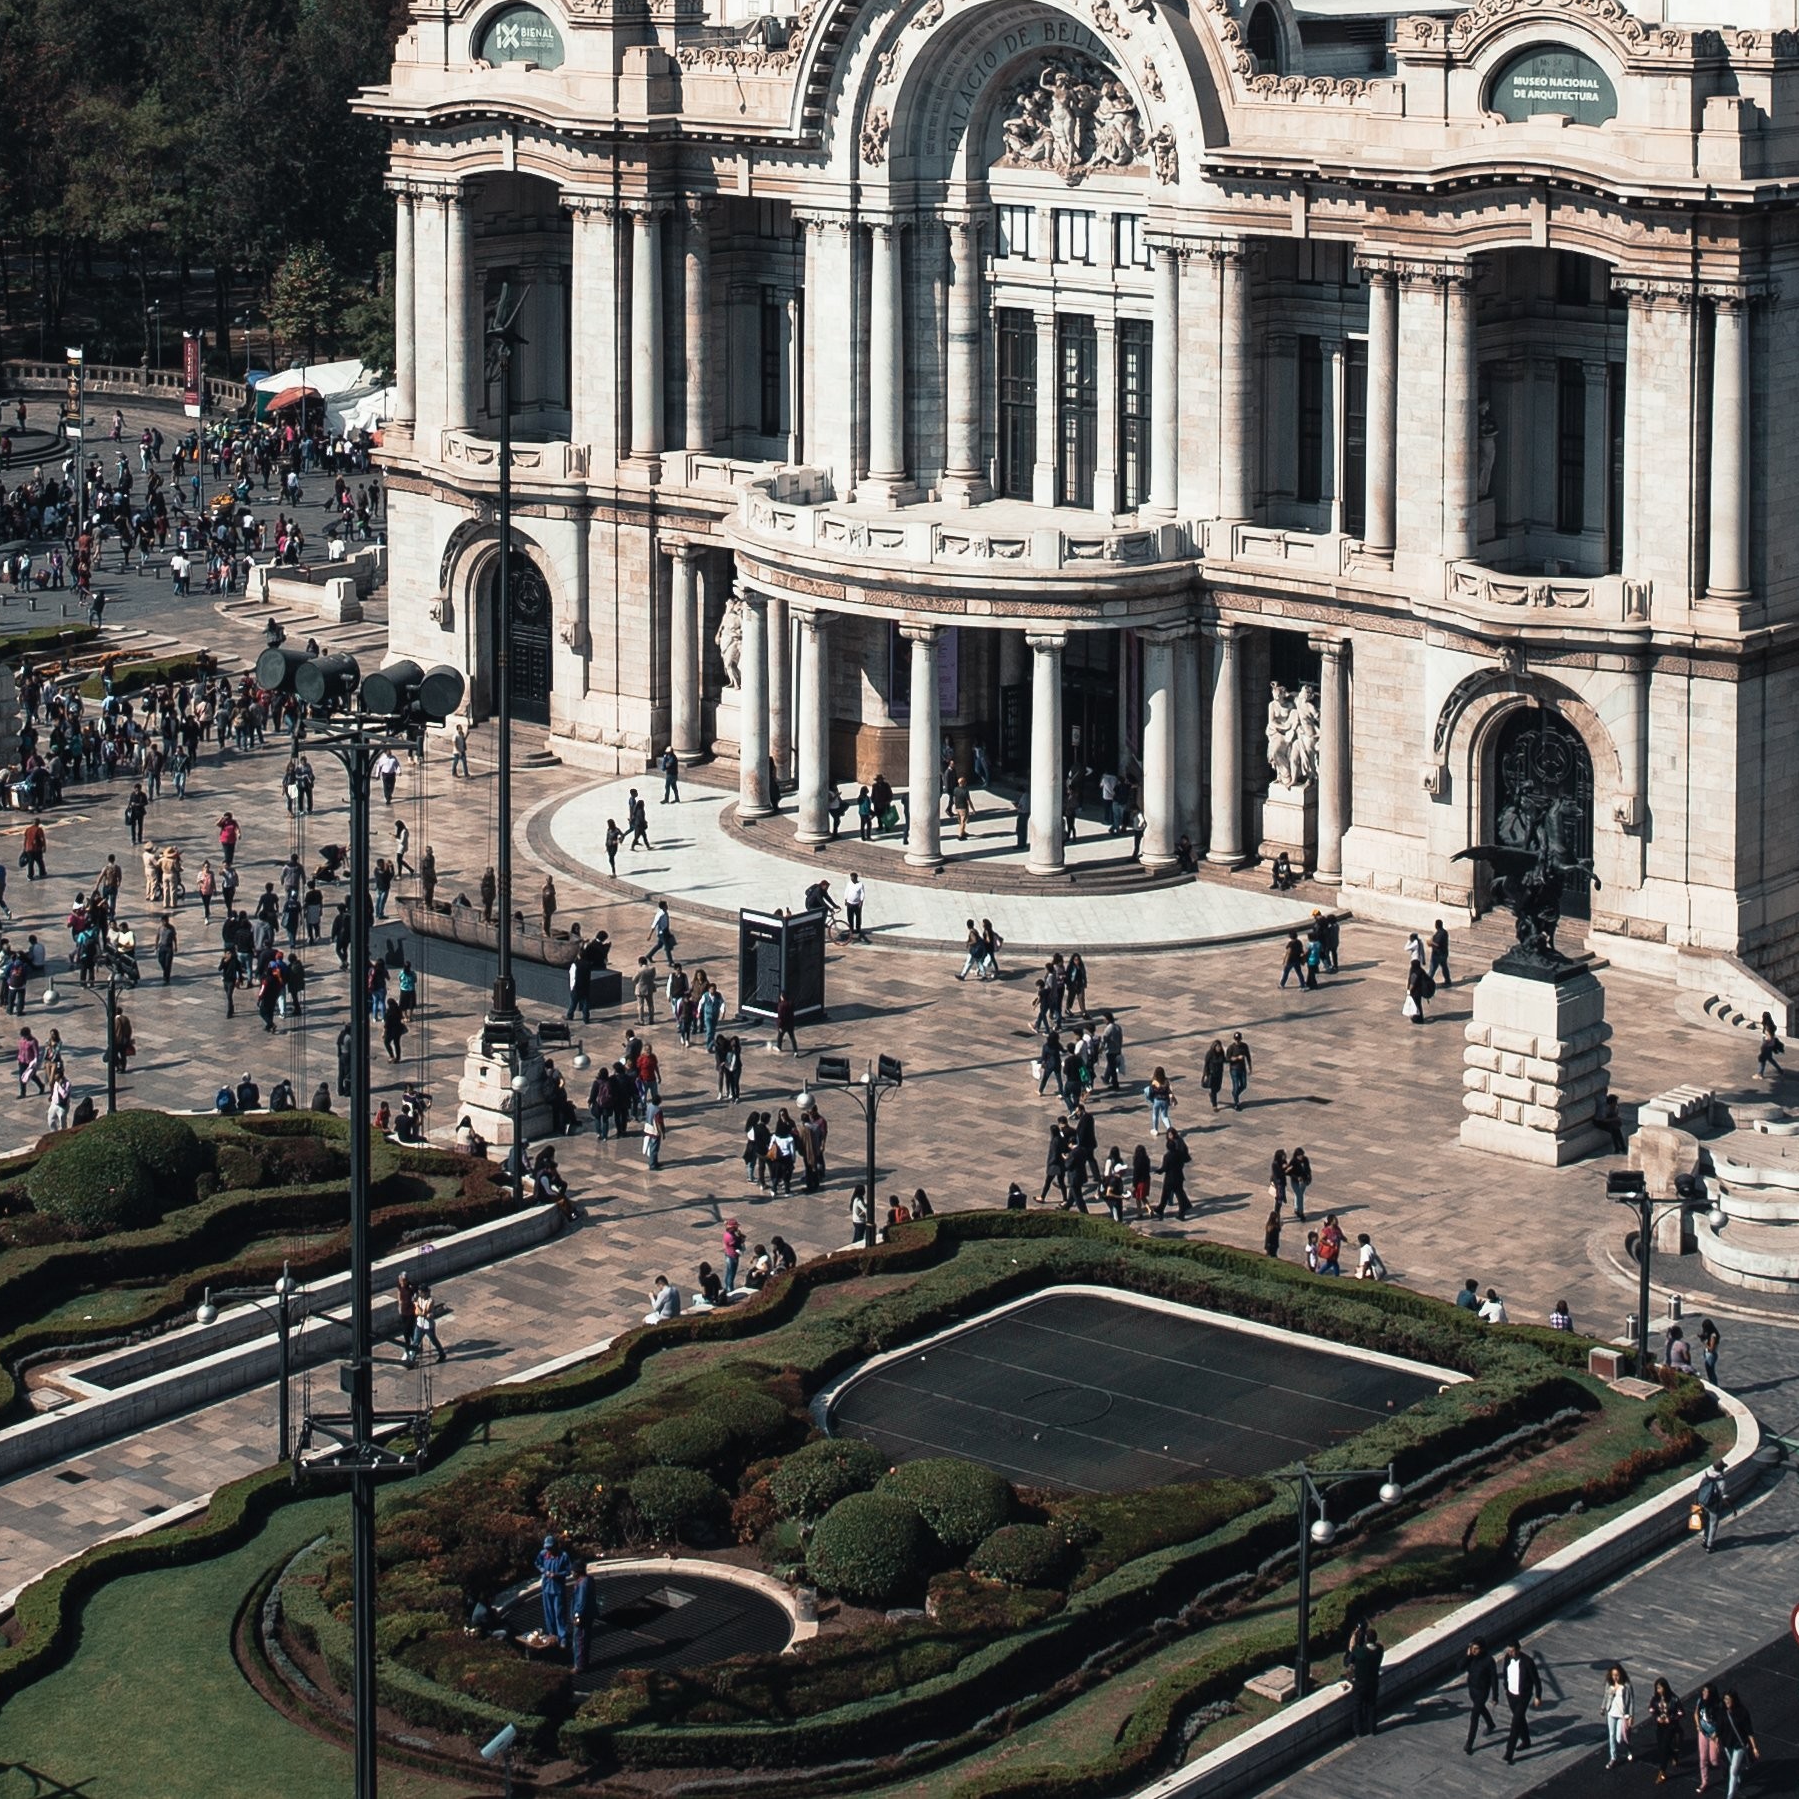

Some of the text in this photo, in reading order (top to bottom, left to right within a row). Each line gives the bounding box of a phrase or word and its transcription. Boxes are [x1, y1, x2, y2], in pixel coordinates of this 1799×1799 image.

[521, 27, 554, 38] BIENAL
[948, 50, 997, 152] PALACIO
[1003, 26, 1032, 53] DE
[1513, 76, 1600, 89] MUSEO NACIONAL
[1513, 89, 1600, 102] DE ARQUITECTURA
